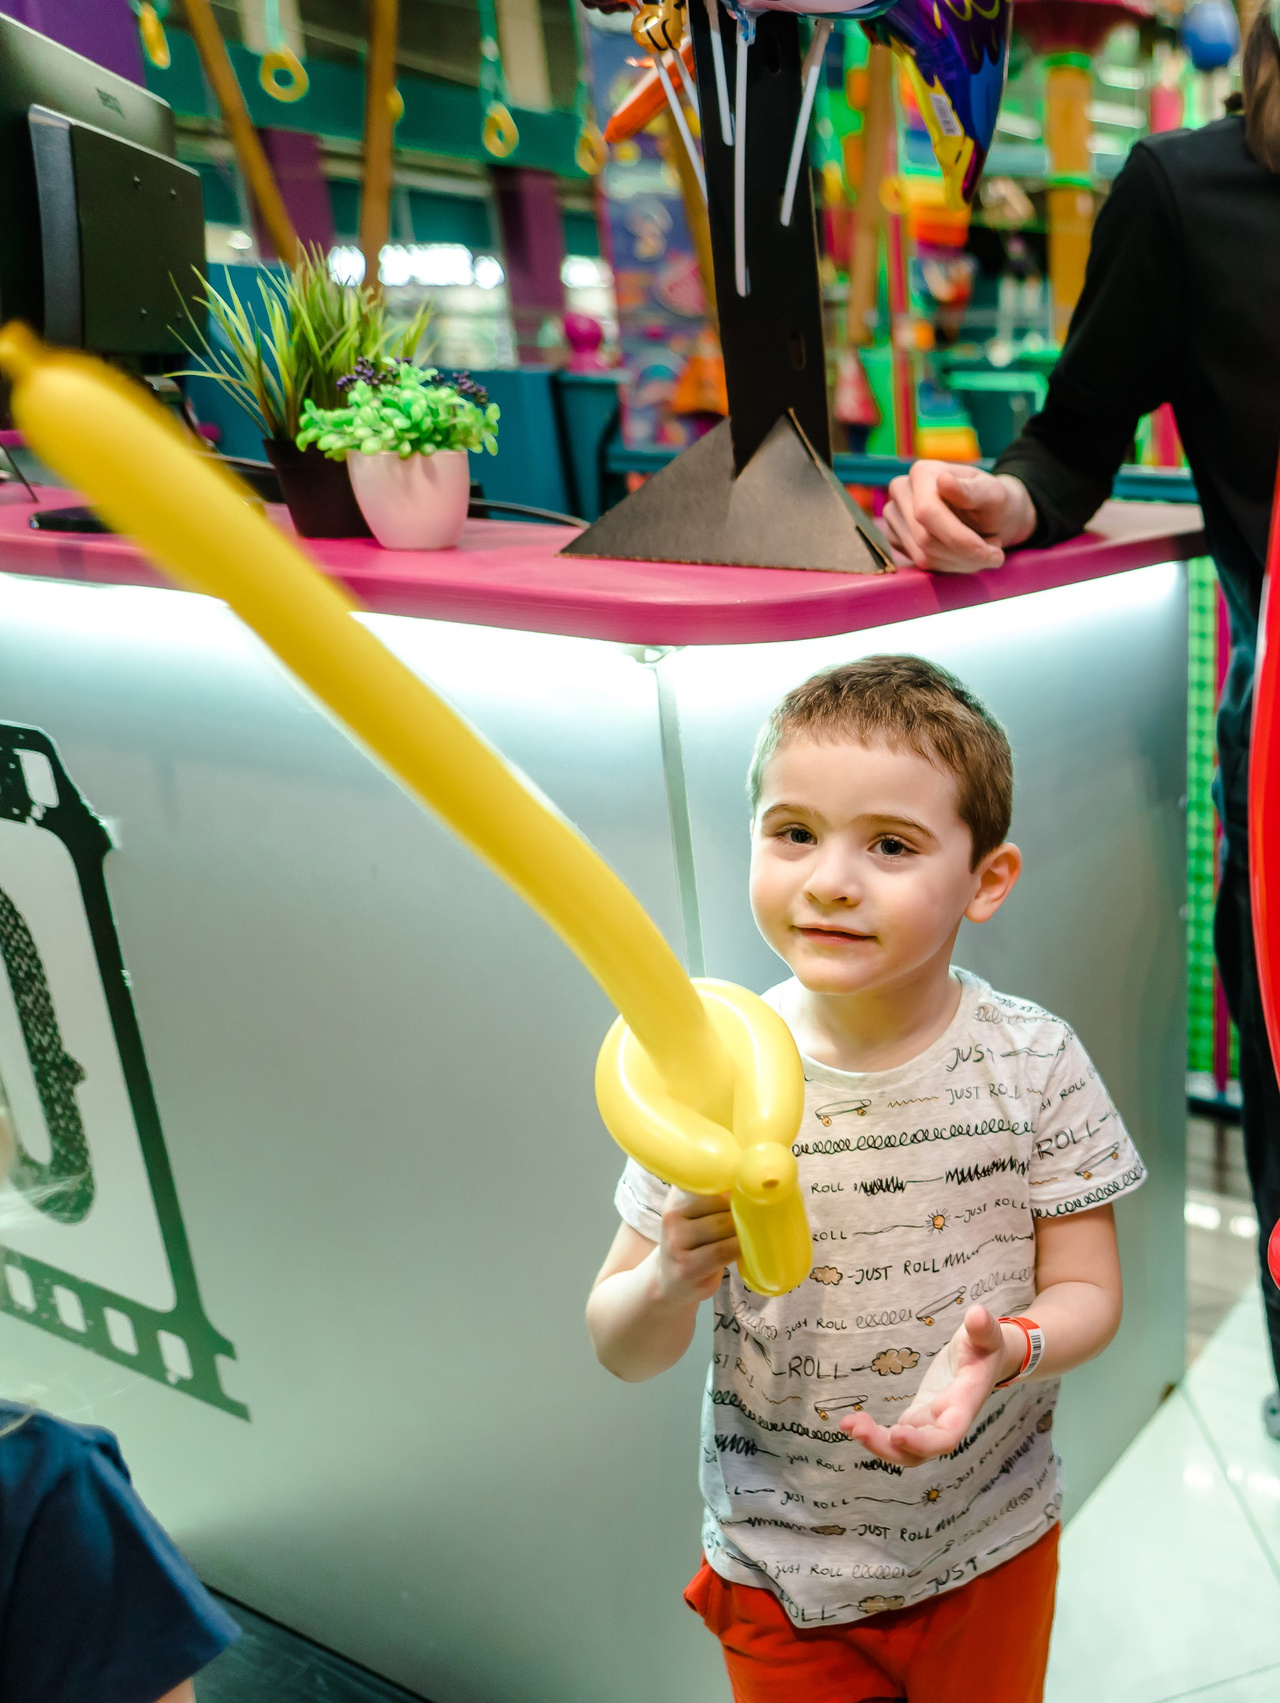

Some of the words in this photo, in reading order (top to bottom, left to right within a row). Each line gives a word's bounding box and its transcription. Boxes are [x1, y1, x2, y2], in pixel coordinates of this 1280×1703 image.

[946, 1086, 980, 1106] JUST
[989, 1083, 1021, 1100] ROLL
[1059, 1078, 1086, 1101] ROLL
[1035, 1120, 1101, 1159] ROLL
[811, 1182, 844, 1194] ROLL
[994, 1198, 1028, 1210] ROLL
[903, 1258, 940, 1276] ROLL
[784, 1318, 808, 1341] just
[816, 1317, 848, 1331] ROLL
[788, 1355, 850, 1380] ROLL
[816, 1457, 846, 1472] ROLL
[780, 1491, 805, 1506] JUST
[813, 1498, 851, 1509] ROLL
[900, 1527, 933, 1542] ROLL
[773, 1560, 800, 1580] just
[810, 1563, 844, 1578] ROLL
